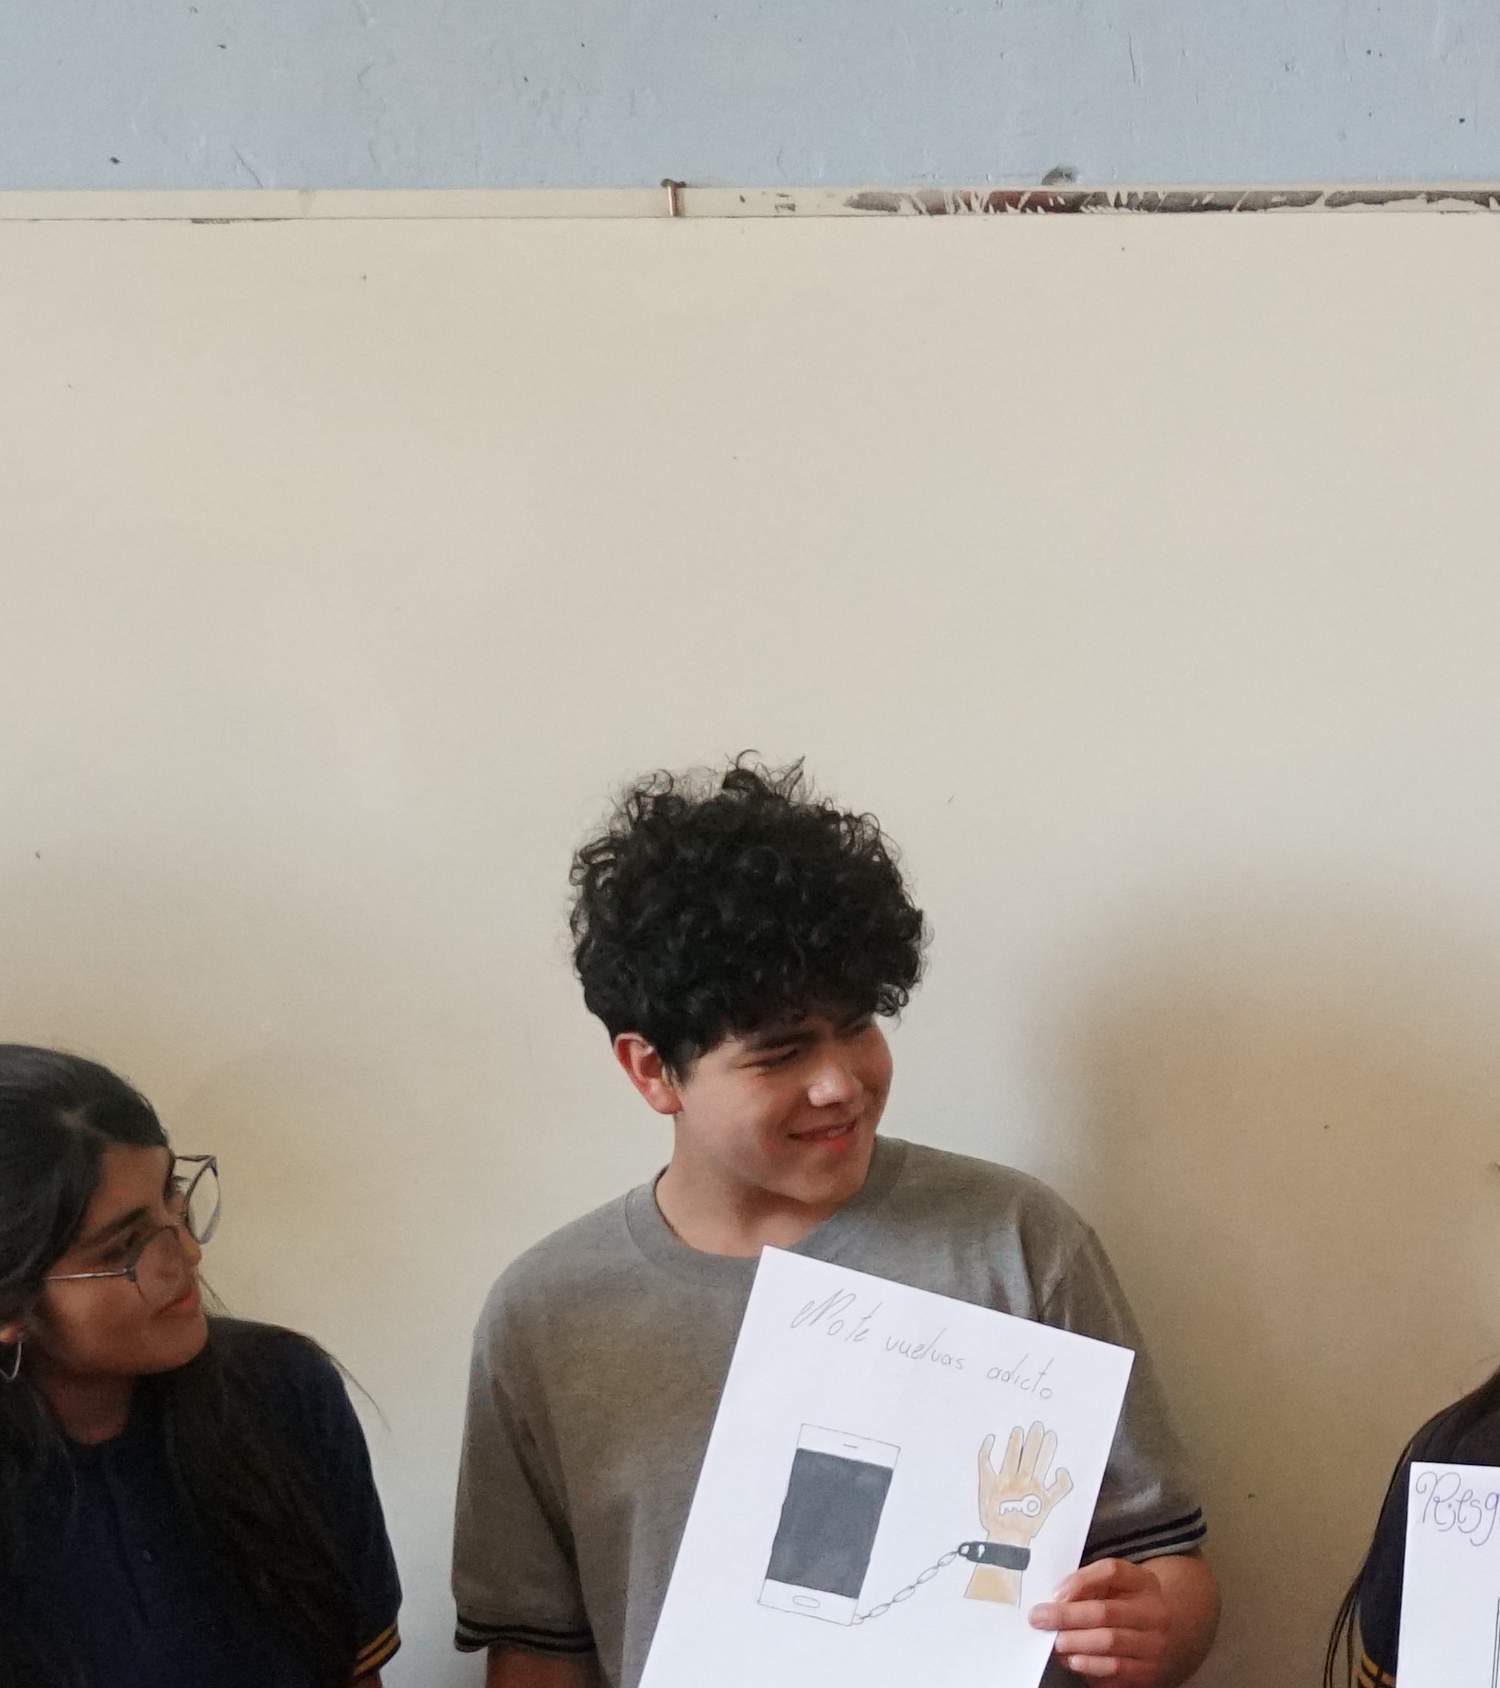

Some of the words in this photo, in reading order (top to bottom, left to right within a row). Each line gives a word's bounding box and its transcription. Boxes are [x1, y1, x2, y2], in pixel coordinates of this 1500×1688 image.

[790, 1289, 857, 1336] No
[845, 1302, 884, 1342] te
[987, 1353, 1054, 1400] adicto
